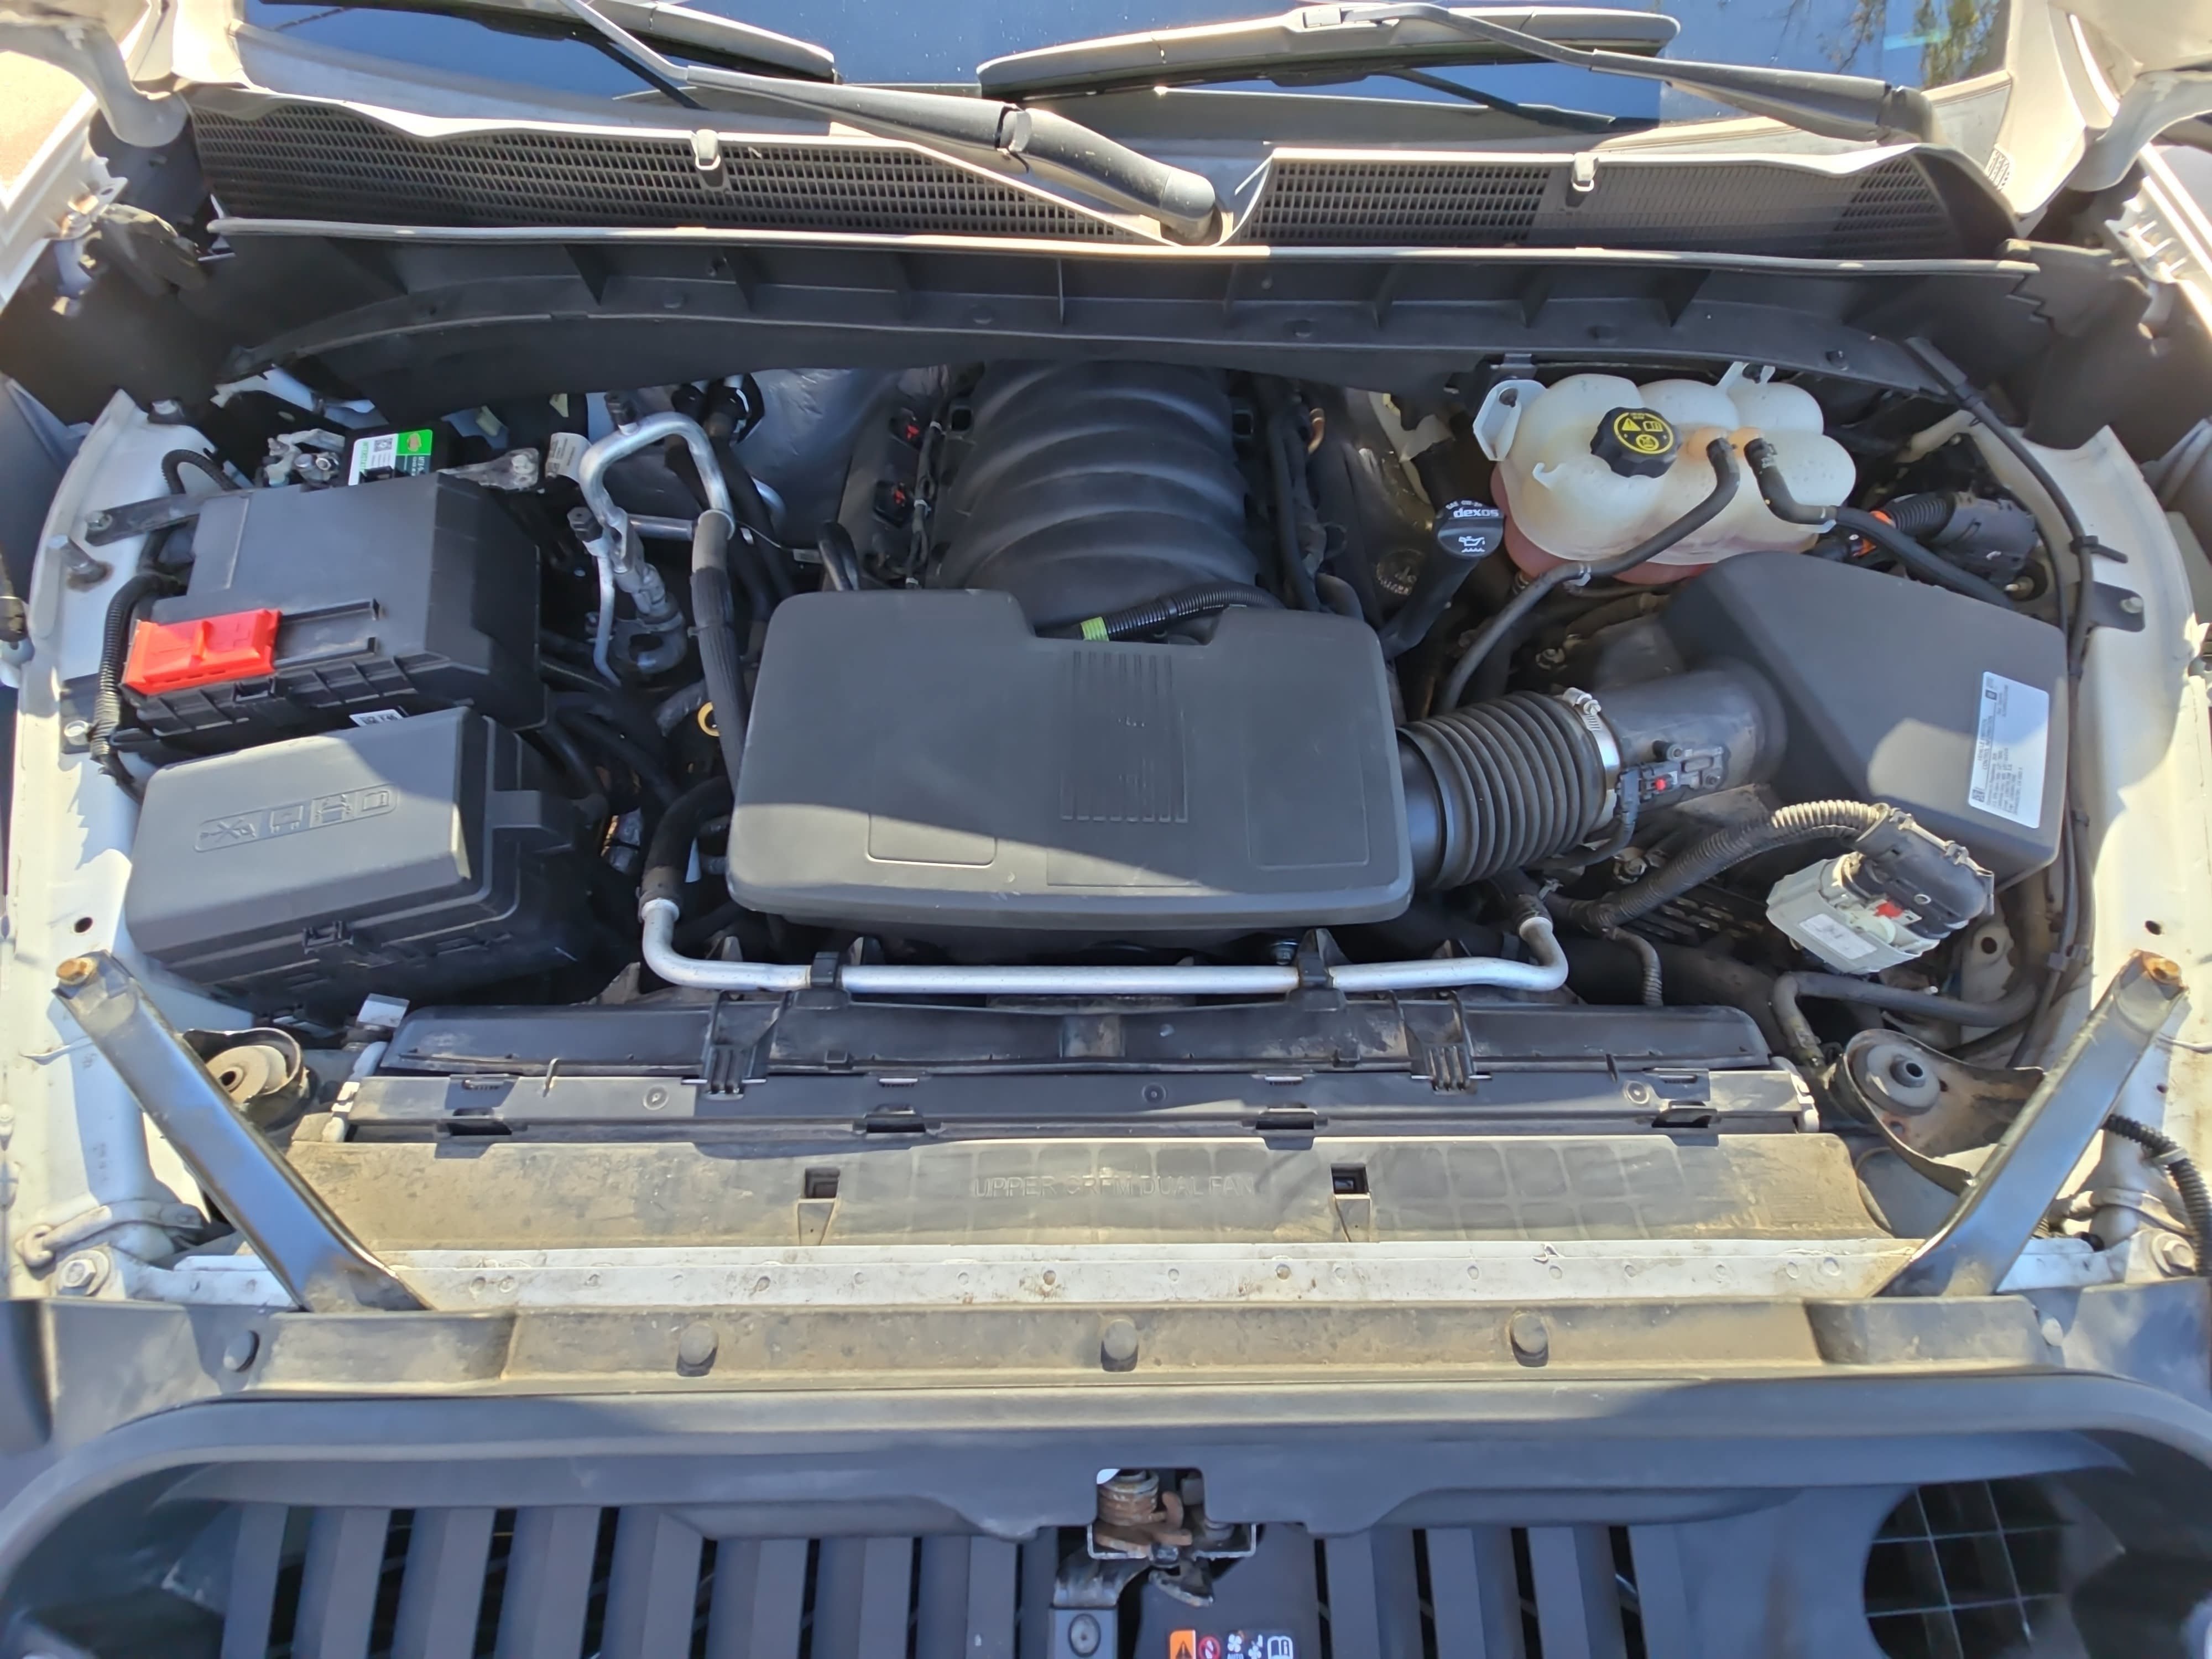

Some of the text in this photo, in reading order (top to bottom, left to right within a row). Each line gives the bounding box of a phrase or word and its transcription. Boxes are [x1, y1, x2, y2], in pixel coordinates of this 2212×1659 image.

[1453, 507, 1499, 518] dexos
[975, 1176, 1057, 1197] UPPER
[1140, 1175, 1204, 1196] DUAL
[1209, 1176, 1255, 1196] FAN
